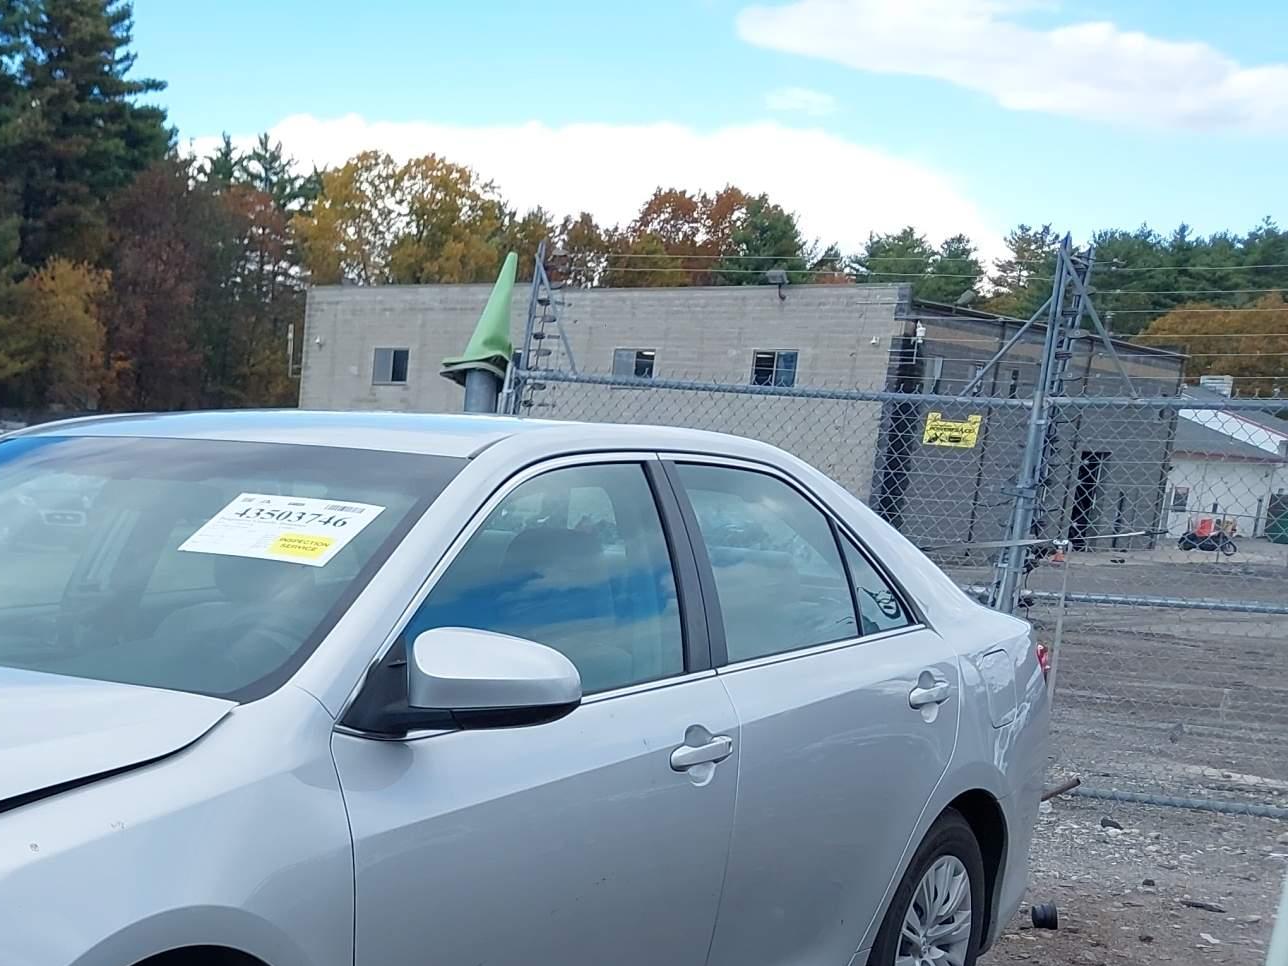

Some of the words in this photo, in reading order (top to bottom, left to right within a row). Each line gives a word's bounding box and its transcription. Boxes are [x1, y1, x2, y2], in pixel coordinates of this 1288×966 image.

[234, 507, 352, 528] 43503746
[278, 537, 331, 548] INSPECTION
[279, 543, 319, 552] SERVICE
